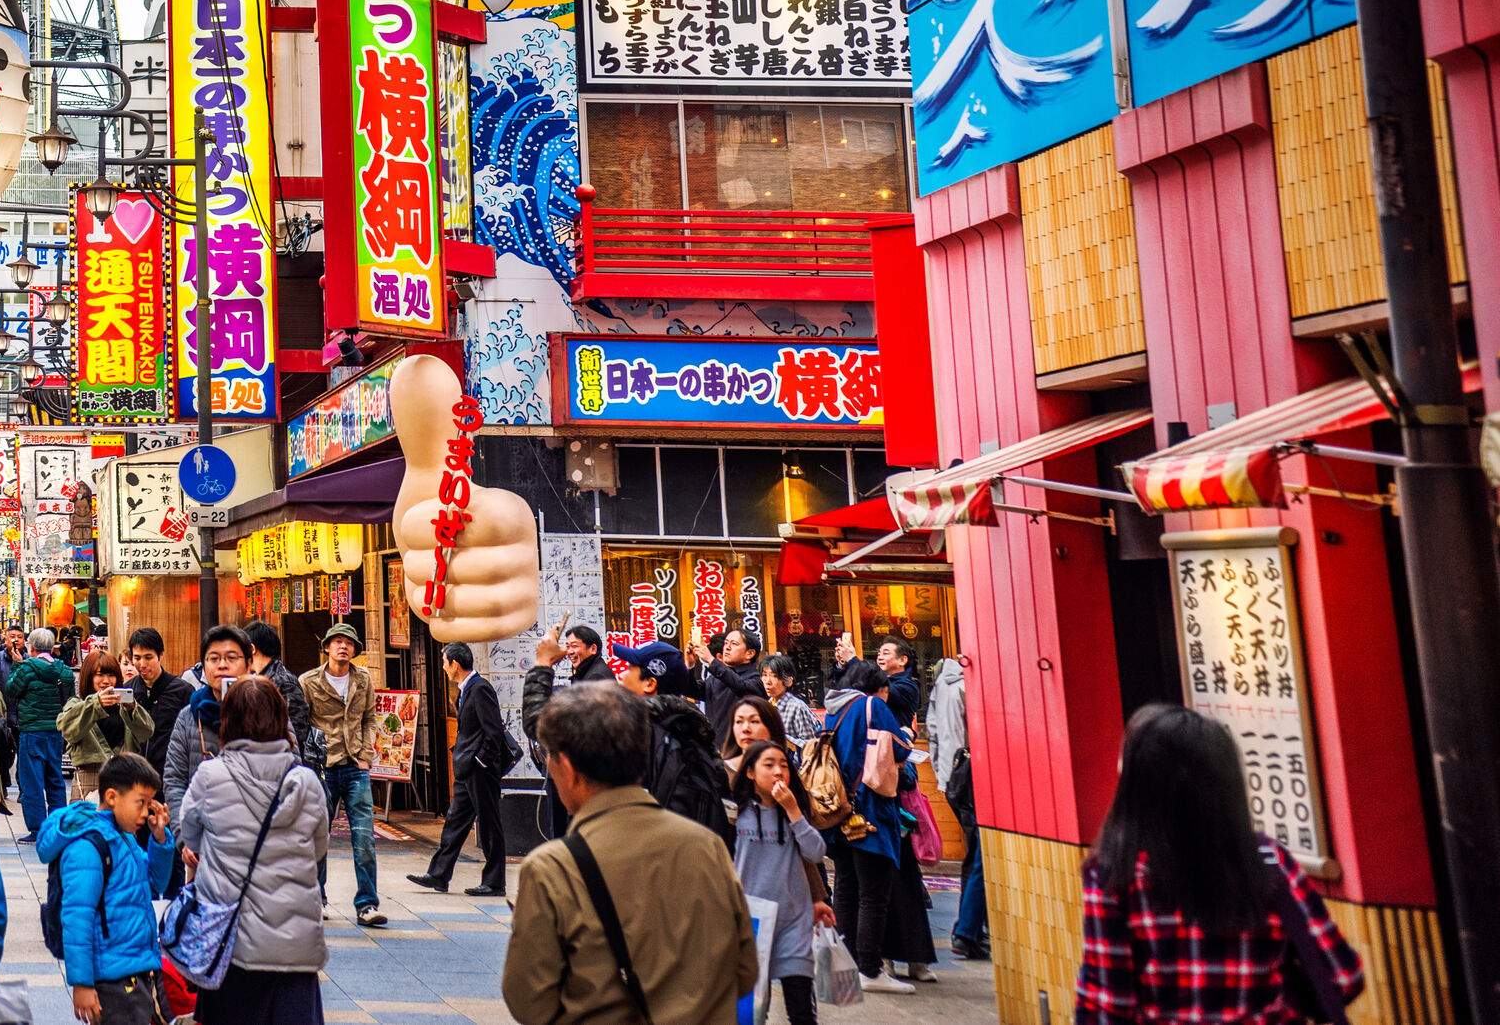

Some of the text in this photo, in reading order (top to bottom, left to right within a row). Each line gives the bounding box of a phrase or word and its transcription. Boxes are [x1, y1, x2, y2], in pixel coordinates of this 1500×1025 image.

[358, 50, 432, 265] 横綱
[85, 249, 135, 384] 通天閣
[138, 249, 156, 383] TSUTENKAKU
[181, 224, 267, 373] 横綱
[372, 273, 432, 320] 酒処
[111, 389, 159, 412] 横綱
[579, 347, 604, 412] 新世界
[605, 362, 773, 402] 日本一の串かつ
[656, 569, 678, 636] ソースの
[1200, 559, 1228, 694] 天丼
[1242, 558, 1271, 697] ふぐ天丼
[1264, 558, 1295, 698] ふぐカツ丼
